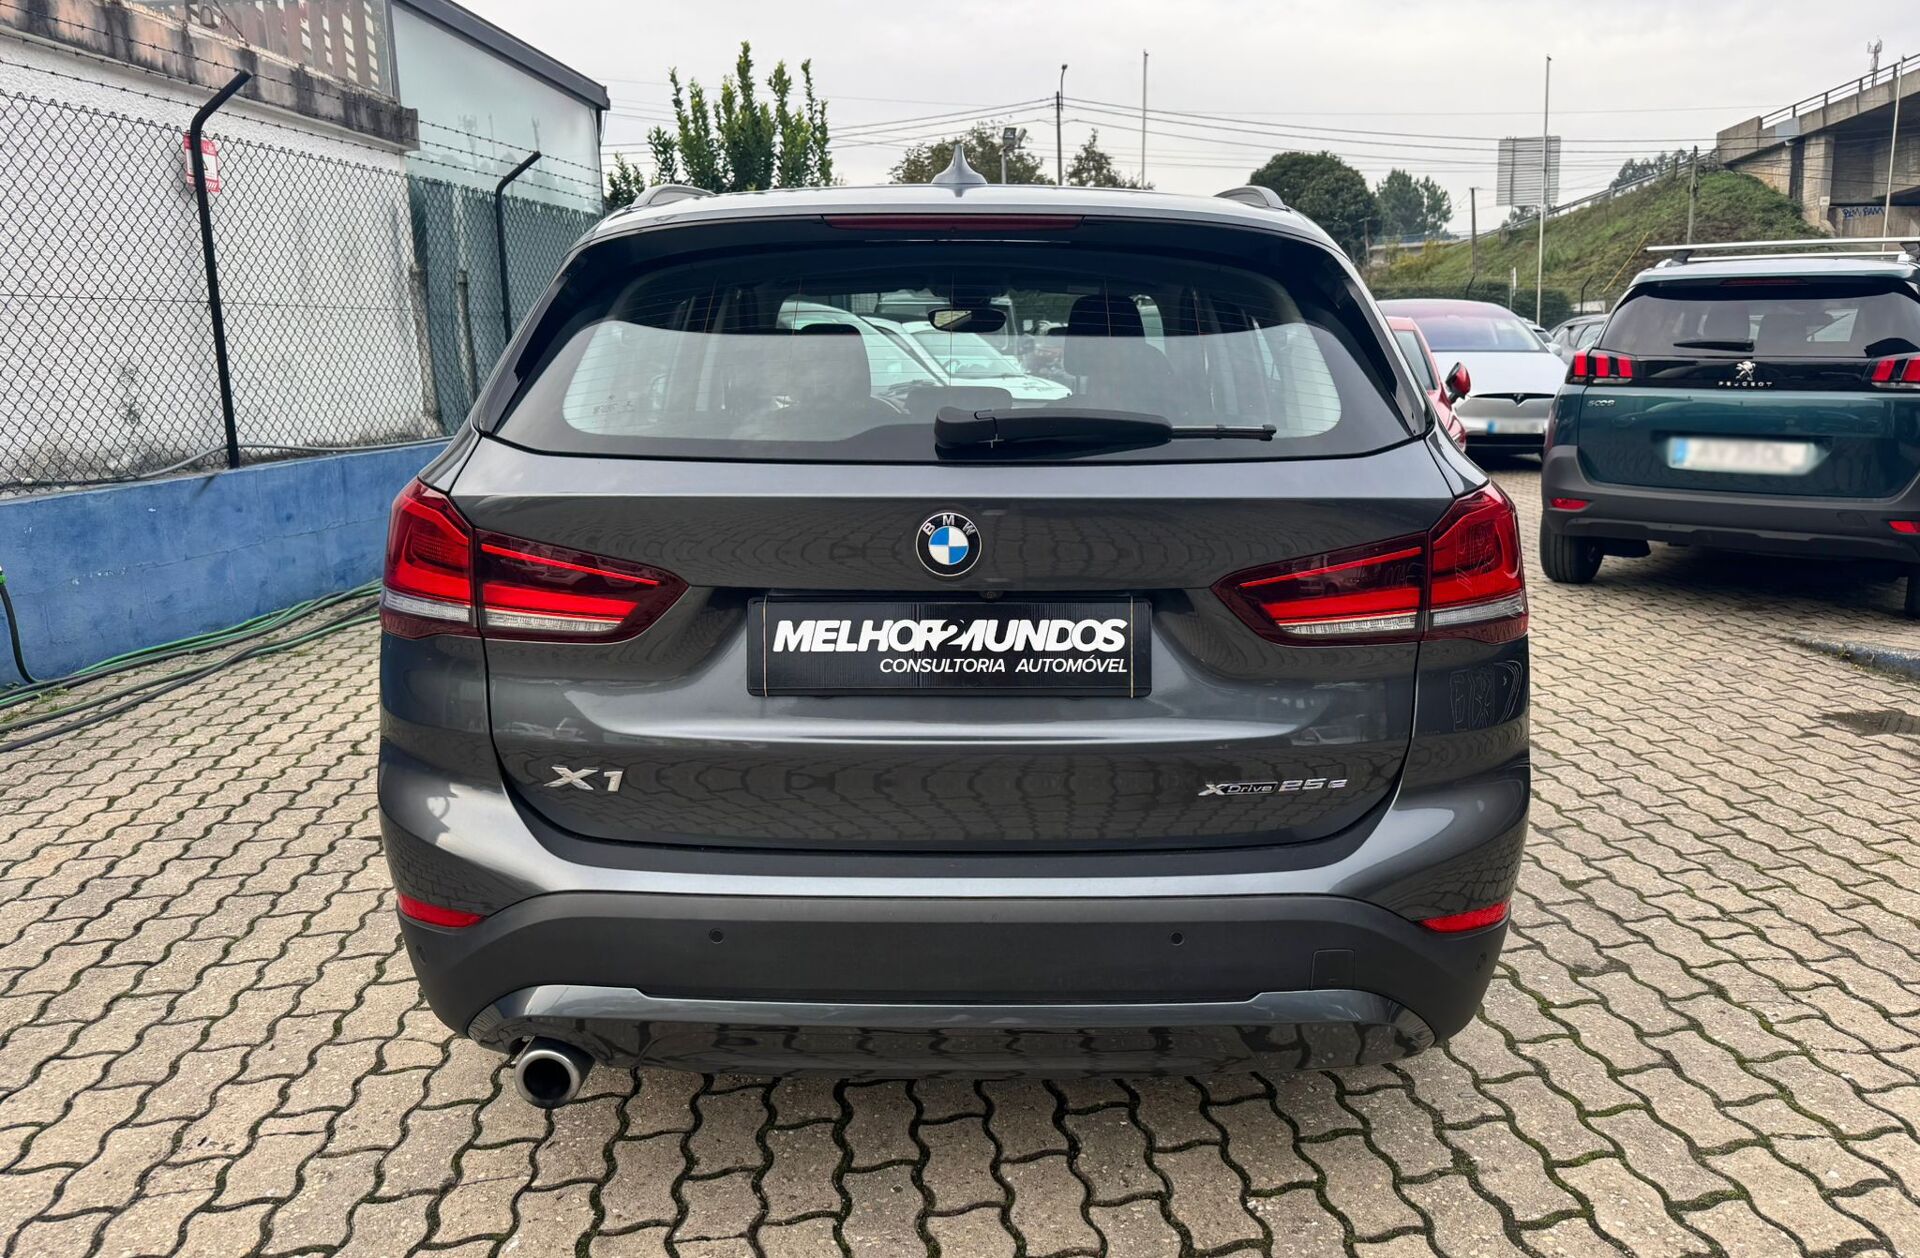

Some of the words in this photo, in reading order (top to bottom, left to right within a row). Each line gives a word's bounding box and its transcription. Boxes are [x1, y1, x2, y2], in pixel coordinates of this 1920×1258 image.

[922, 513, 976, 536] BMW
[879, 658, 1006, 673] CONSULTORIA
[1015, 654, 1128, 673] AUTOMÓVEL
[543, 765, 624, 792] X1
